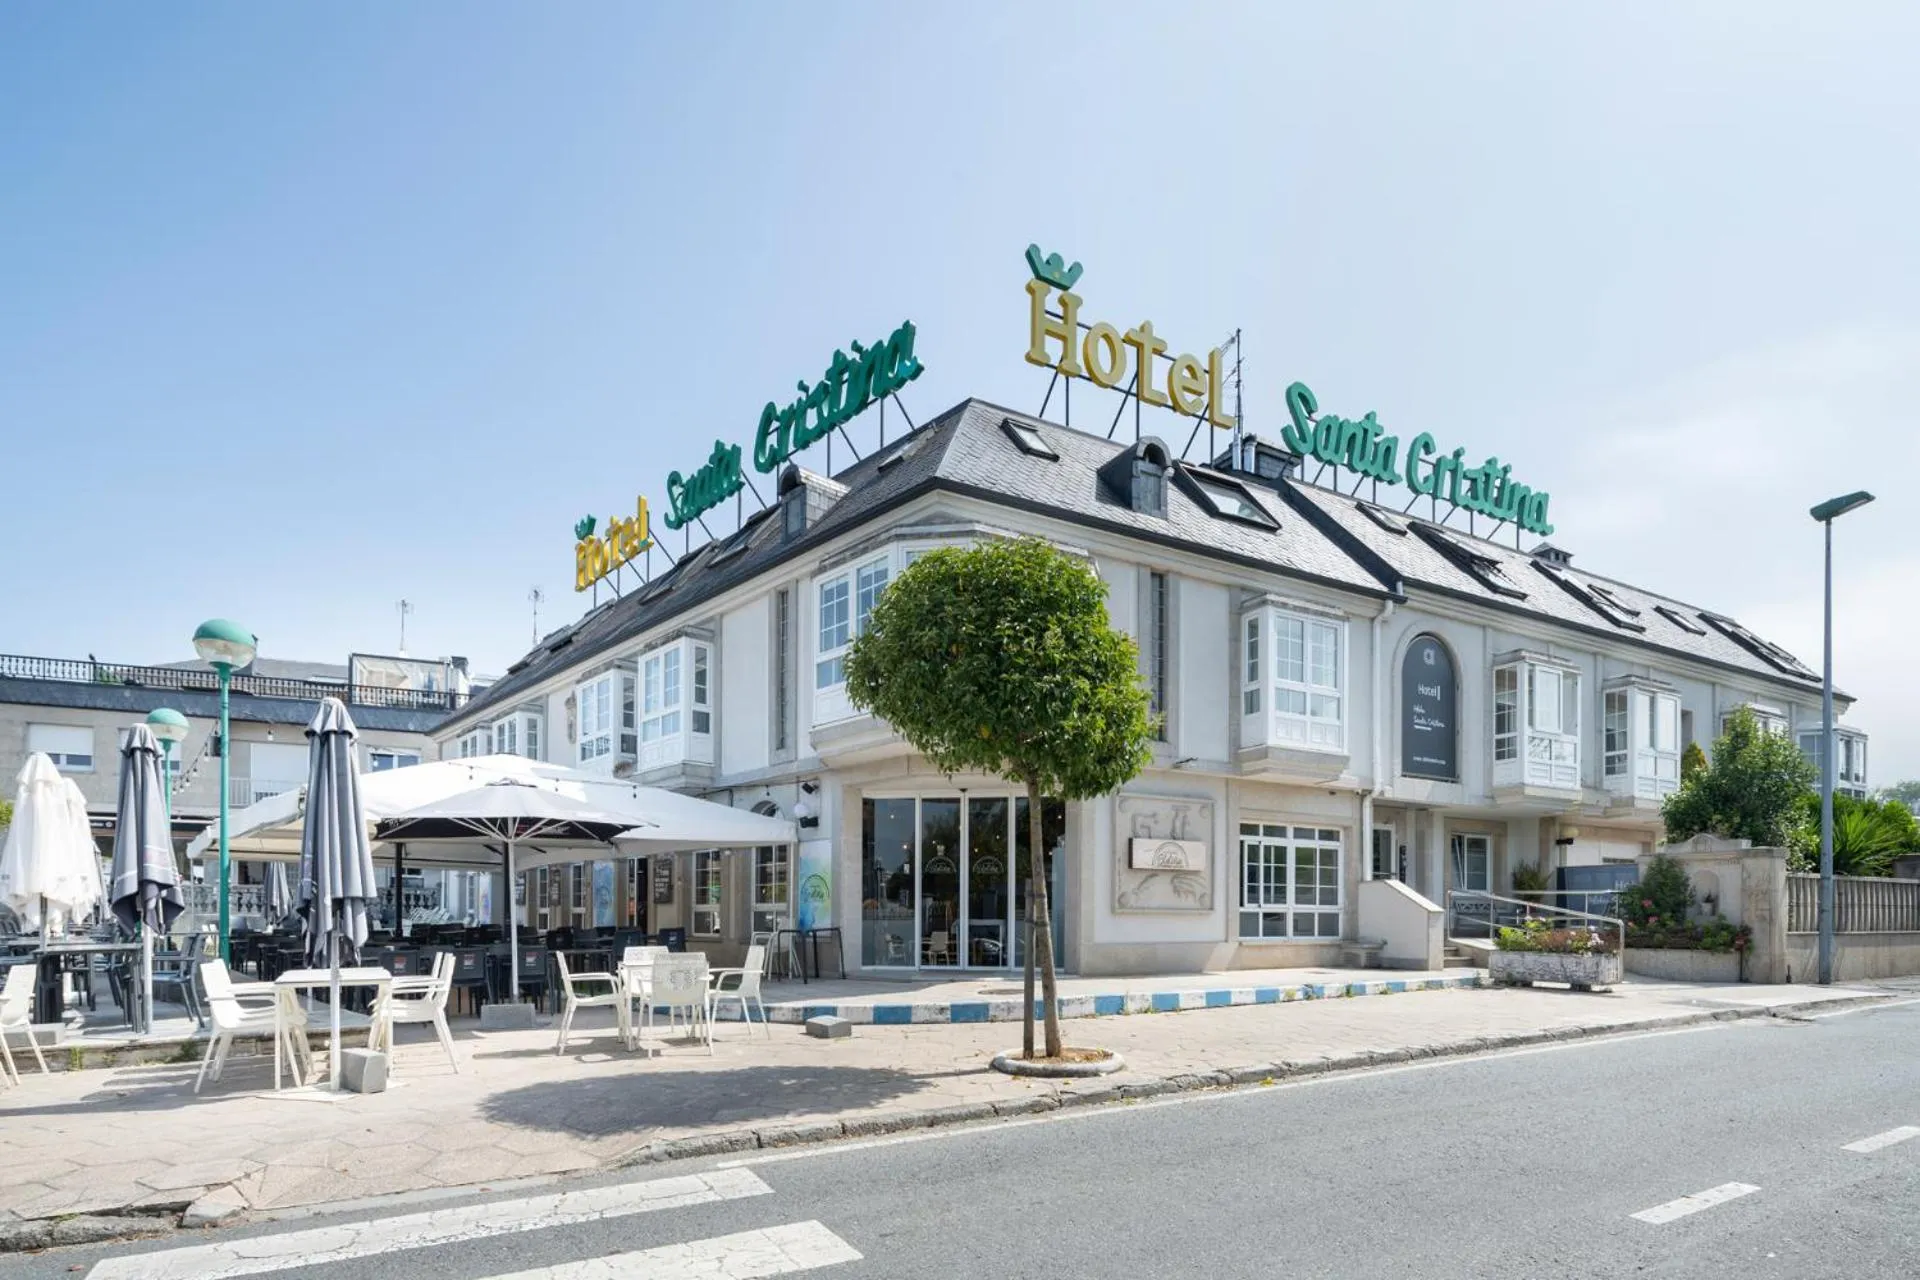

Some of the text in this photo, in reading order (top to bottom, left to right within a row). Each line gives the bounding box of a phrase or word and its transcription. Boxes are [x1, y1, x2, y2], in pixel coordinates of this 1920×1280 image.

[575, 319, 925, 593] Hotel Santa Cristina
[1024, 278, 1555, 537] Hotel Santa Cristina
[1417, 683, 1437, 697] Hotel
